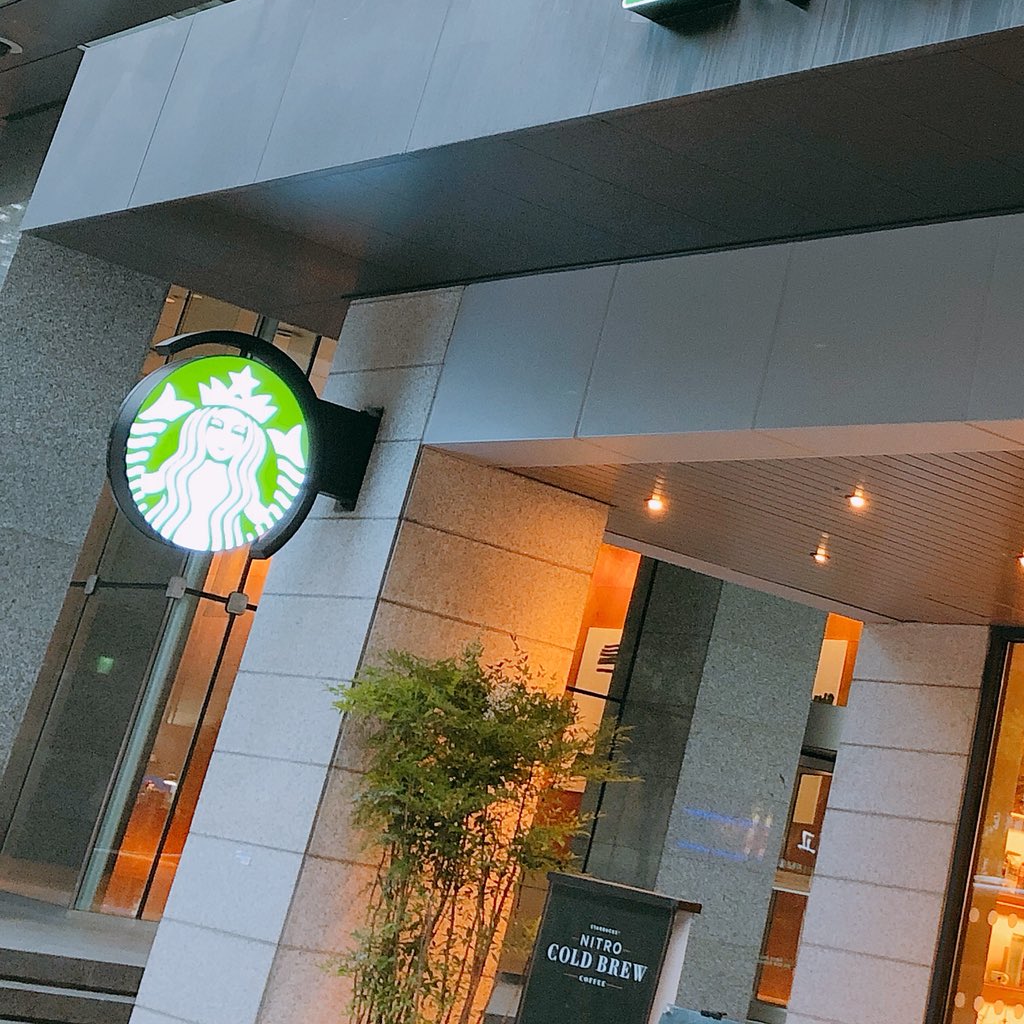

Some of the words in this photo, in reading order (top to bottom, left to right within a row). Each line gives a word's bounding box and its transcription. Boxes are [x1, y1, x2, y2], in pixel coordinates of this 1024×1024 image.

[579, 933, 623, 955] NITRO
[547, 943, 593, 969] COLD
[596, 955, 648, 983] BREW
